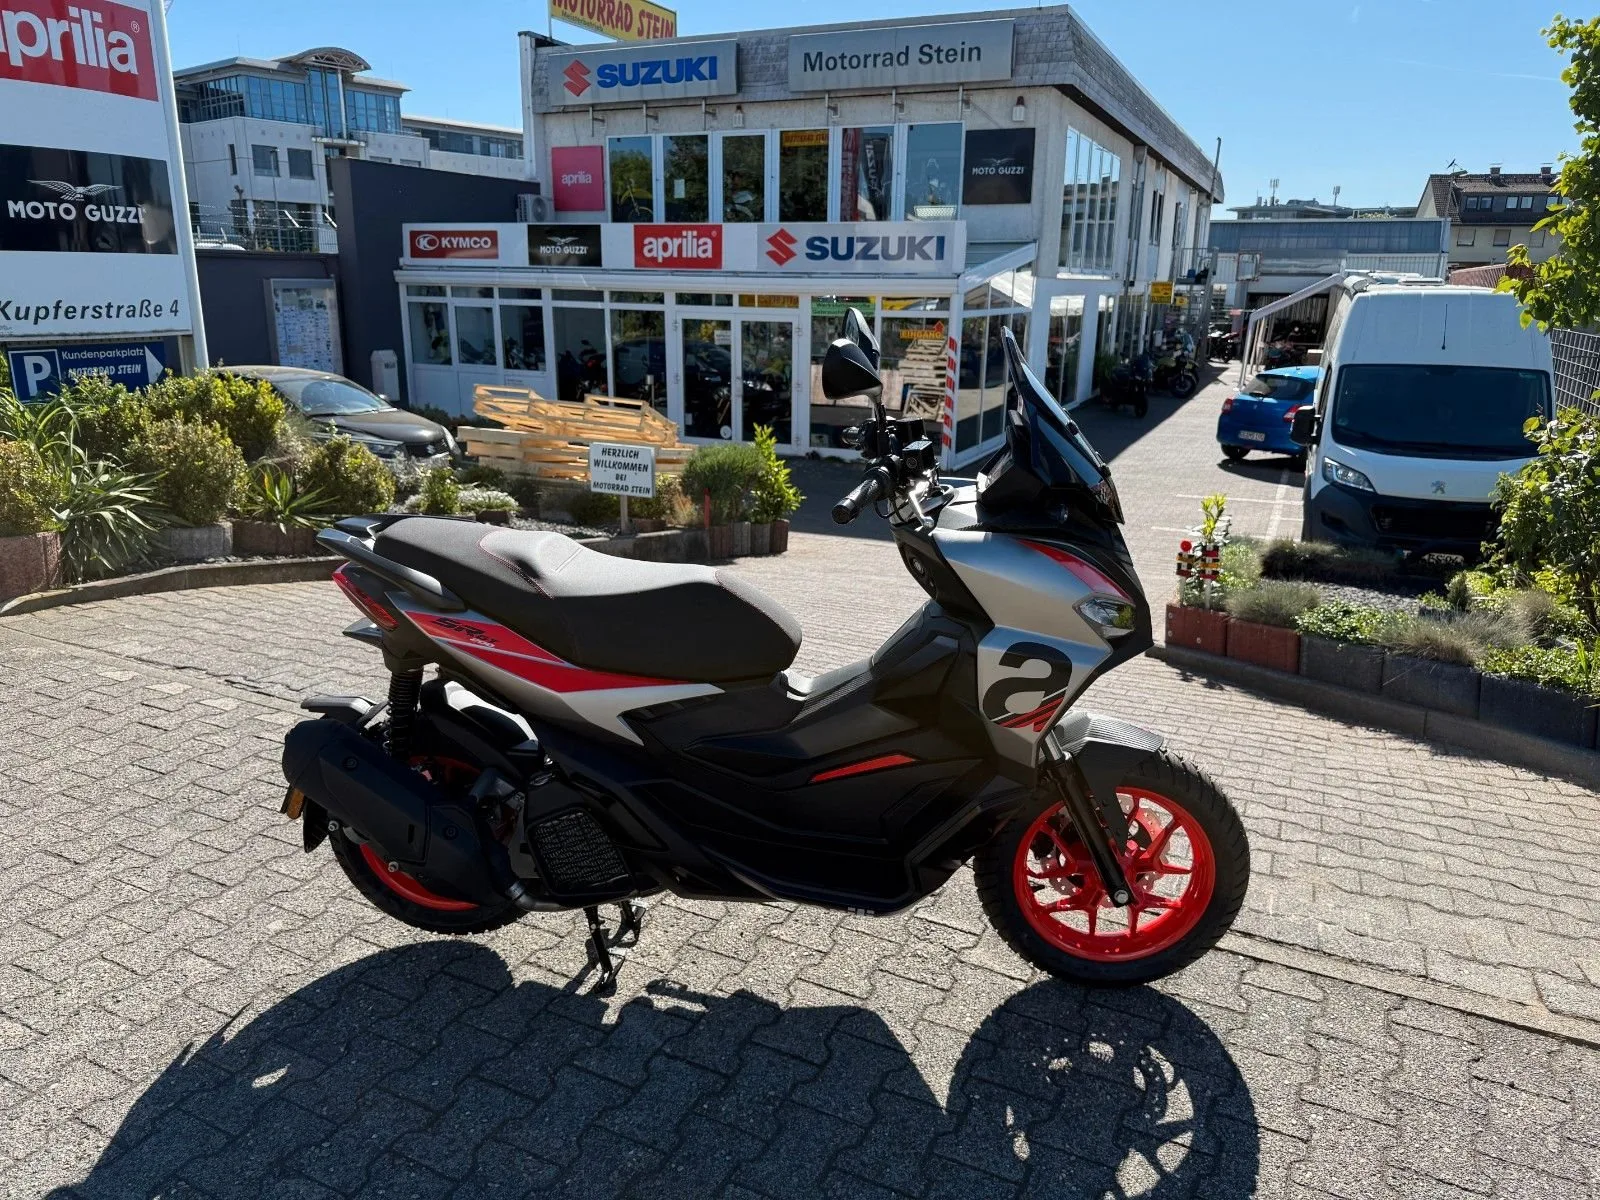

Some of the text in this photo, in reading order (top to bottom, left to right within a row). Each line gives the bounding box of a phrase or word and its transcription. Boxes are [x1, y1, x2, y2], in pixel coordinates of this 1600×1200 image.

[553, 0, 674, 39] TORRAD STEIN
[0, 6, 139, 75] prilia
[803, 41, 982, 72] Motorrad Stein
[597, 56, 718, 89] SUZUKI
[972, 166, 1024, 175] MOTO GUZZI
[561, 171, 593, 185] aprilia
[7, 200, 77, 220] MOTO
[441, 237, 492, 249] KYMCO
[540, 246, 588, 254] MOTO GUZZI
[643, 231, 712, 263] aprilia
[805, 236, 945, 261] SUZUKI
[170, 300, 179, 317] 4
[62, 348, 144, 360] Kundenparkplatz
[24, 356, 51, 396] P
[118, 364, 142, 375] STEIN
[601, 447, 639, 459] HERZLICH
[594, 458, 649, 472] WILLKOMMEN
[615, 473, 627, 481] BEI
[593, 481, 650, 494] MOTORRAD STEIN
